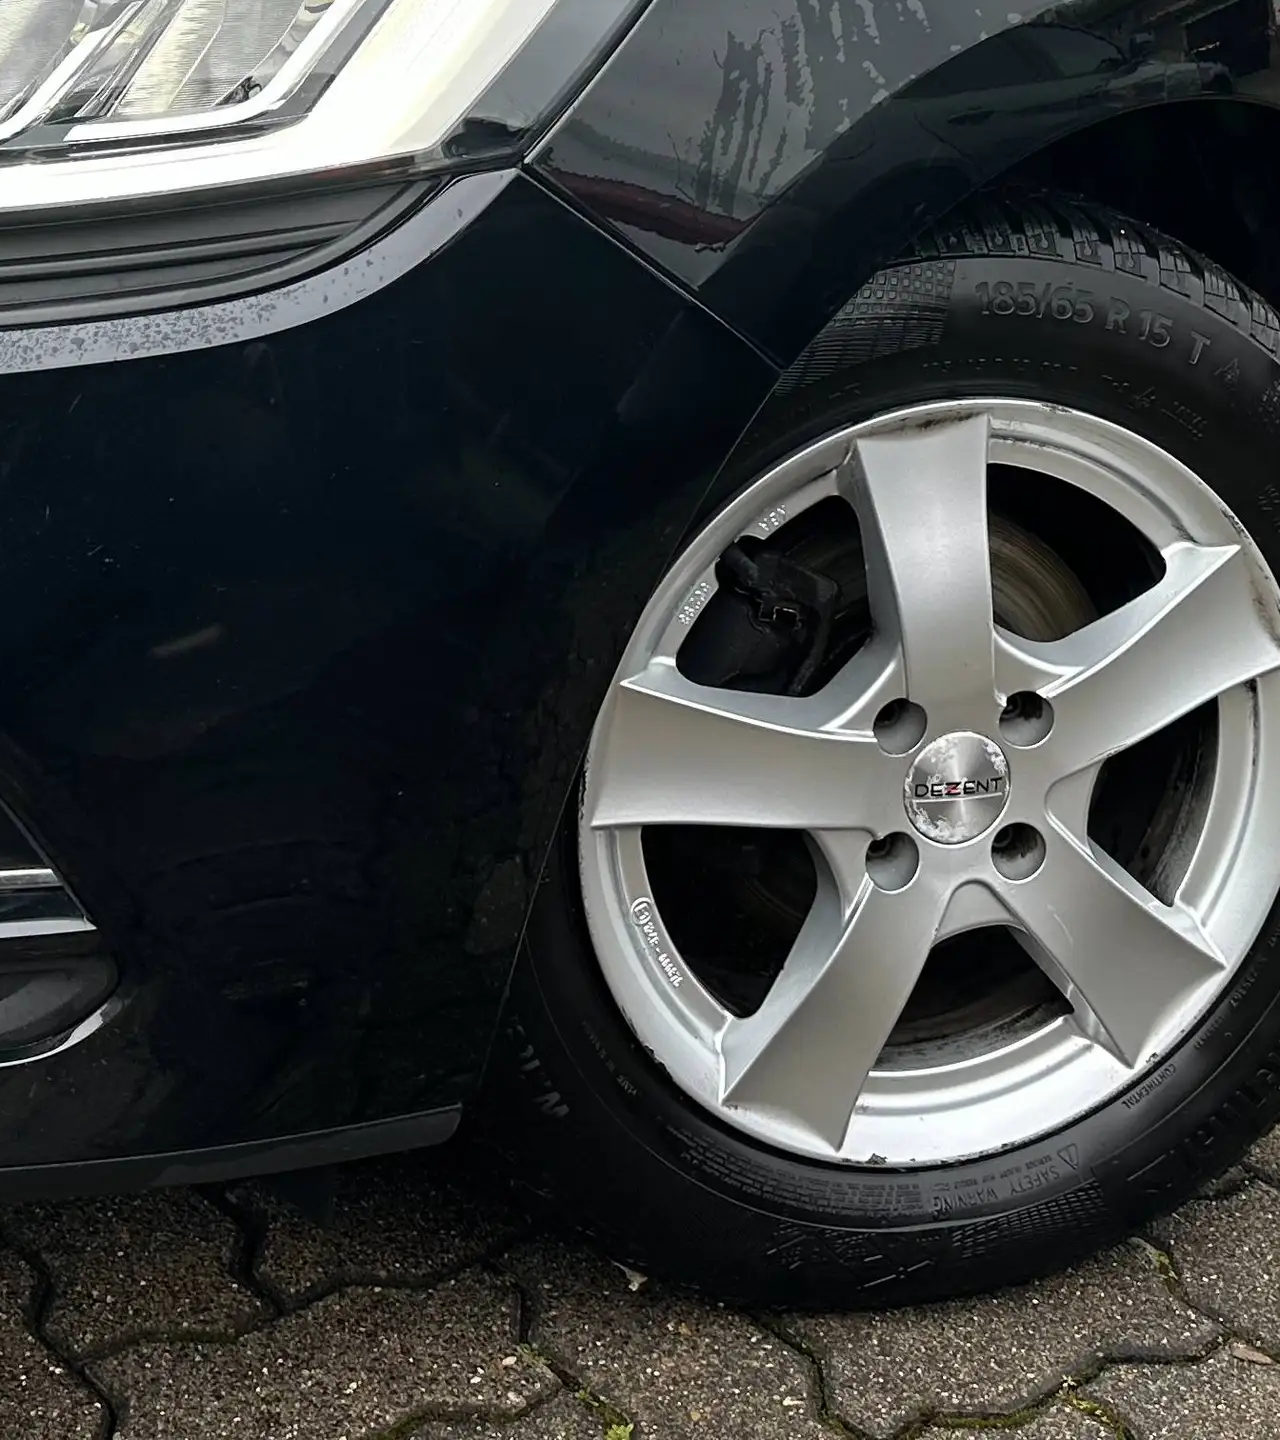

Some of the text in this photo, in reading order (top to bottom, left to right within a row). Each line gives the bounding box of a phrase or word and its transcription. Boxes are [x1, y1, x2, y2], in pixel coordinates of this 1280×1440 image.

[974, 280, 1212, 366] 185/65 R 15 T
[914, 776, 1003, 798] DEZENT
[1009, 1164, 1061, 1196] SAFETY
